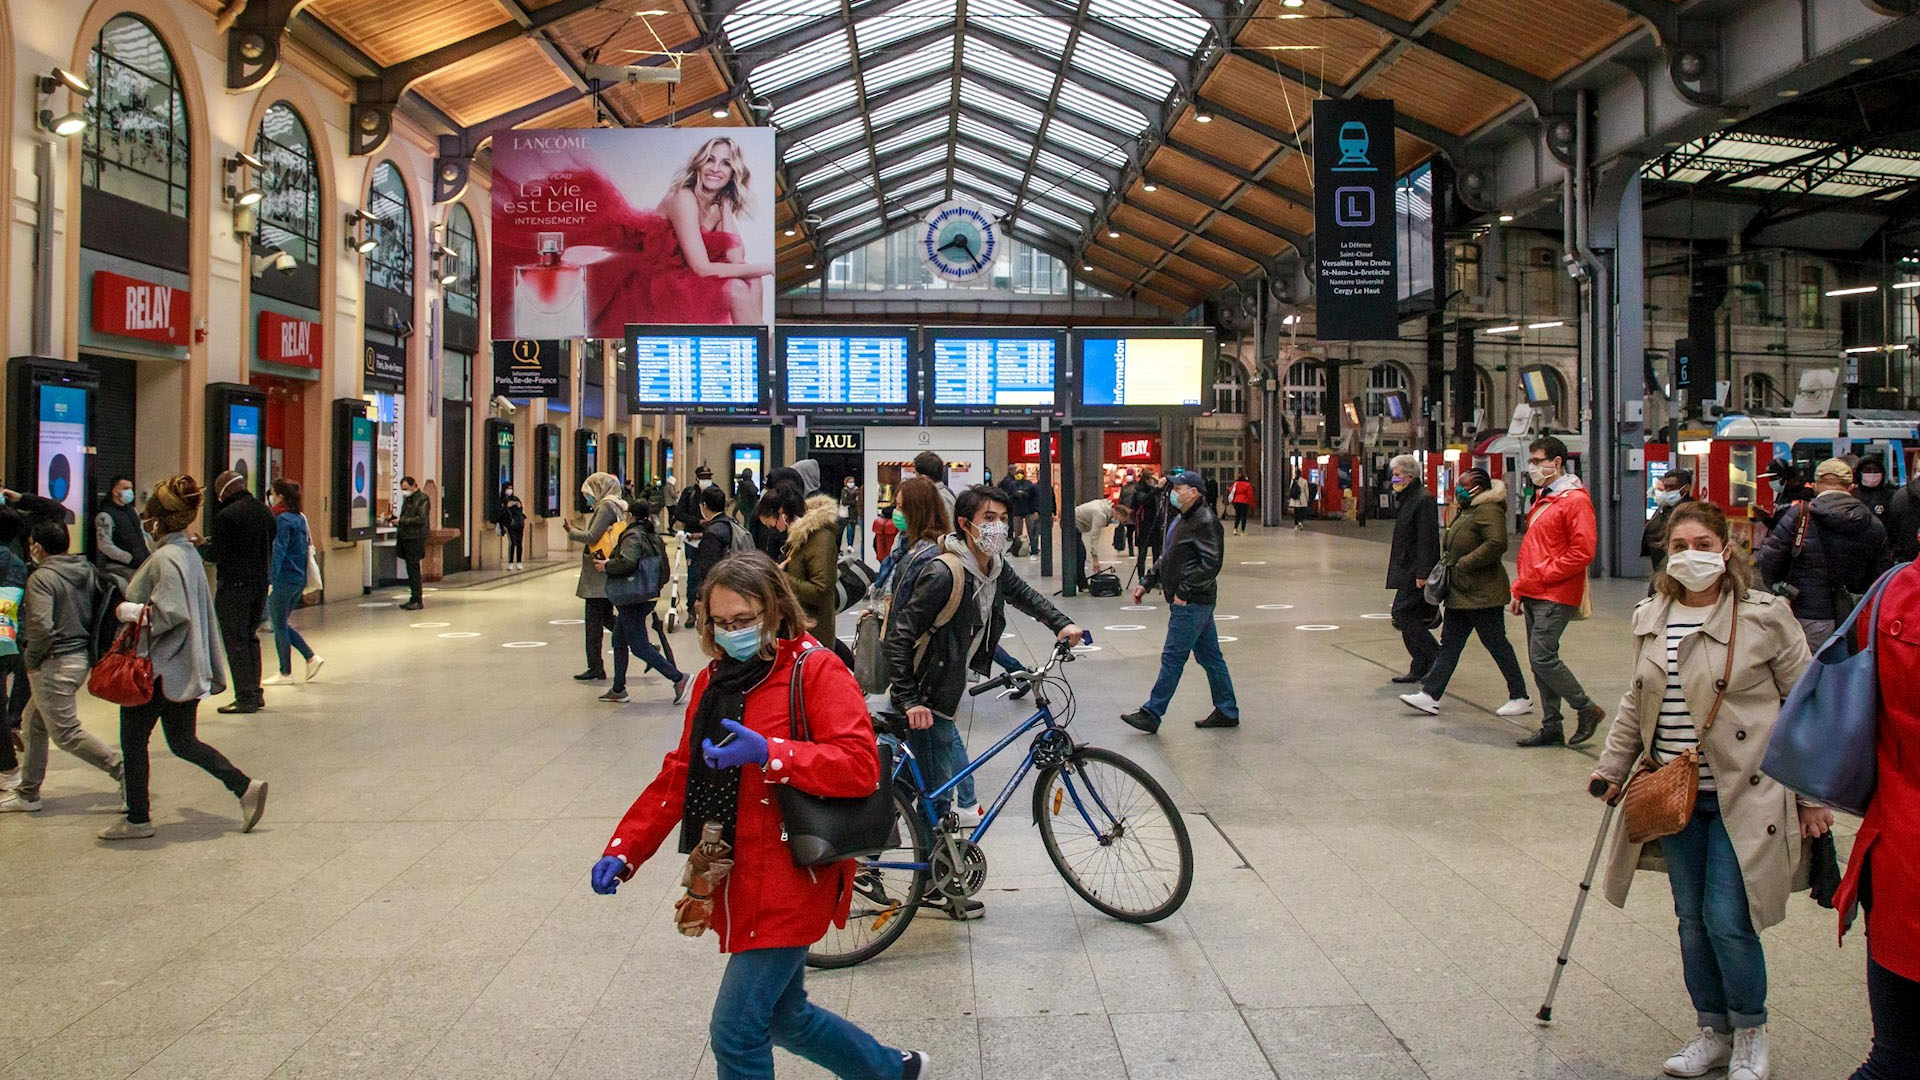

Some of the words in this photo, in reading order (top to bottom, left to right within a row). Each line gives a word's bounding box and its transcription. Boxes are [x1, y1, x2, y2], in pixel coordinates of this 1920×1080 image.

[514, 135, 588, 150] LANCÔME
[520, 183, 542, 197] La
[549, 182, 581, 197] vie
[503, 200, 541, 214] est
[548, 198, 598, 213] belle
[1348, 196, 1362, 217] L
[515, 216, 586, 225] INTENSÉMENT
[125, 286, 172, 330] RELAY
[281, 321, 311, 358] RELAY
[1113, 339, 1124, 404] Information
[495, 376, 513, 384] Paris,
[815, 434, 856, 449] PAUL
[1121, 440, 1149, 457] RELAY
